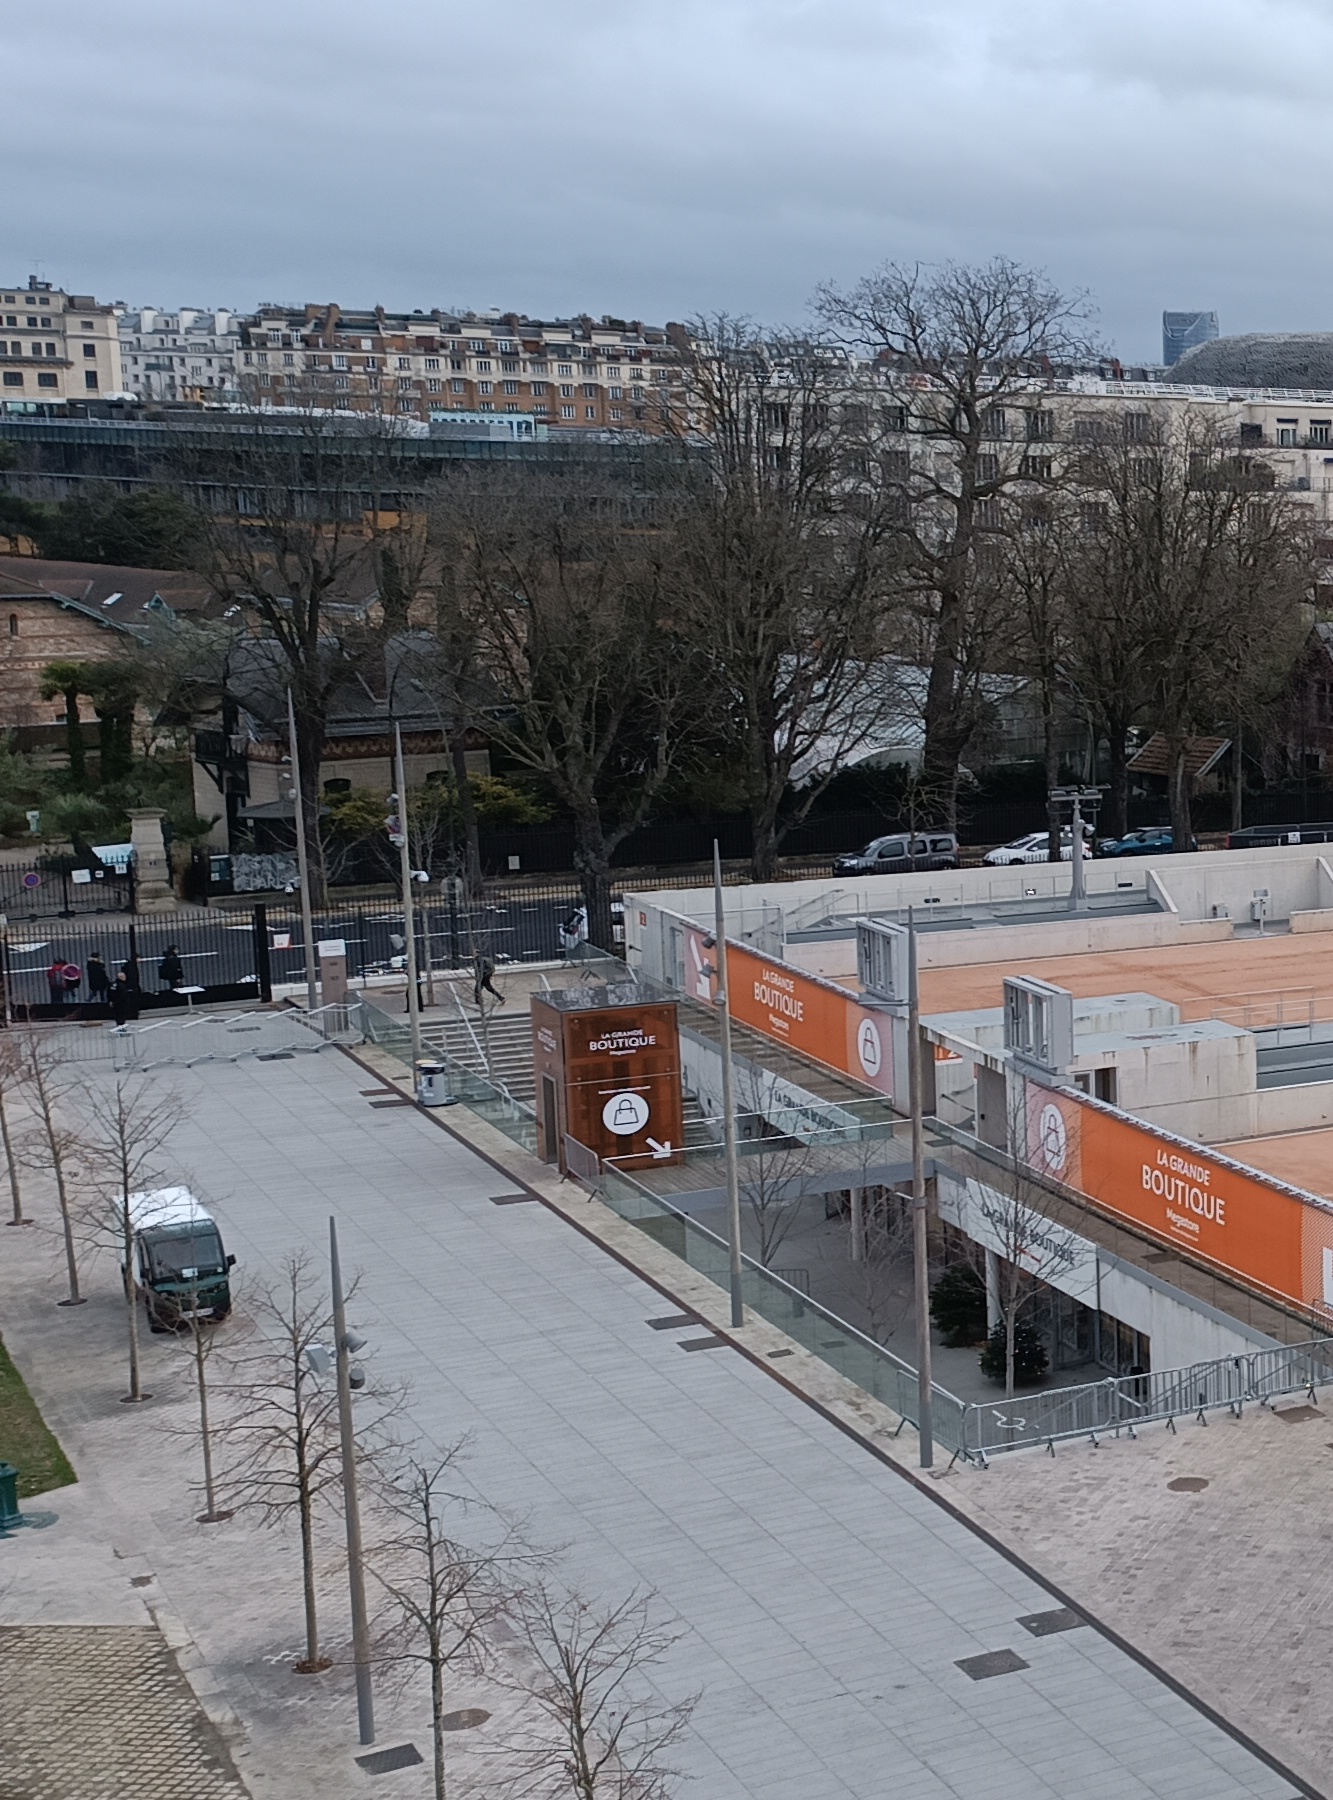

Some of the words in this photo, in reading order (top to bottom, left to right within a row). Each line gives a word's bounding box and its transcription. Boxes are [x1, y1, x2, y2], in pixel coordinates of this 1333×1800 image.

[754, 981, 804, 1022] BOUTIQUE
[589, 1035, 657, 1051] BOUTIQUE
[611, 1029, 644, 1039] GRANDE
[1156, 1148, 1169, 1168] LA
[1169, 1154, 1211, 1187] GRANDE
[1142, 1164, 1226, 1226] BOUTIQUE
